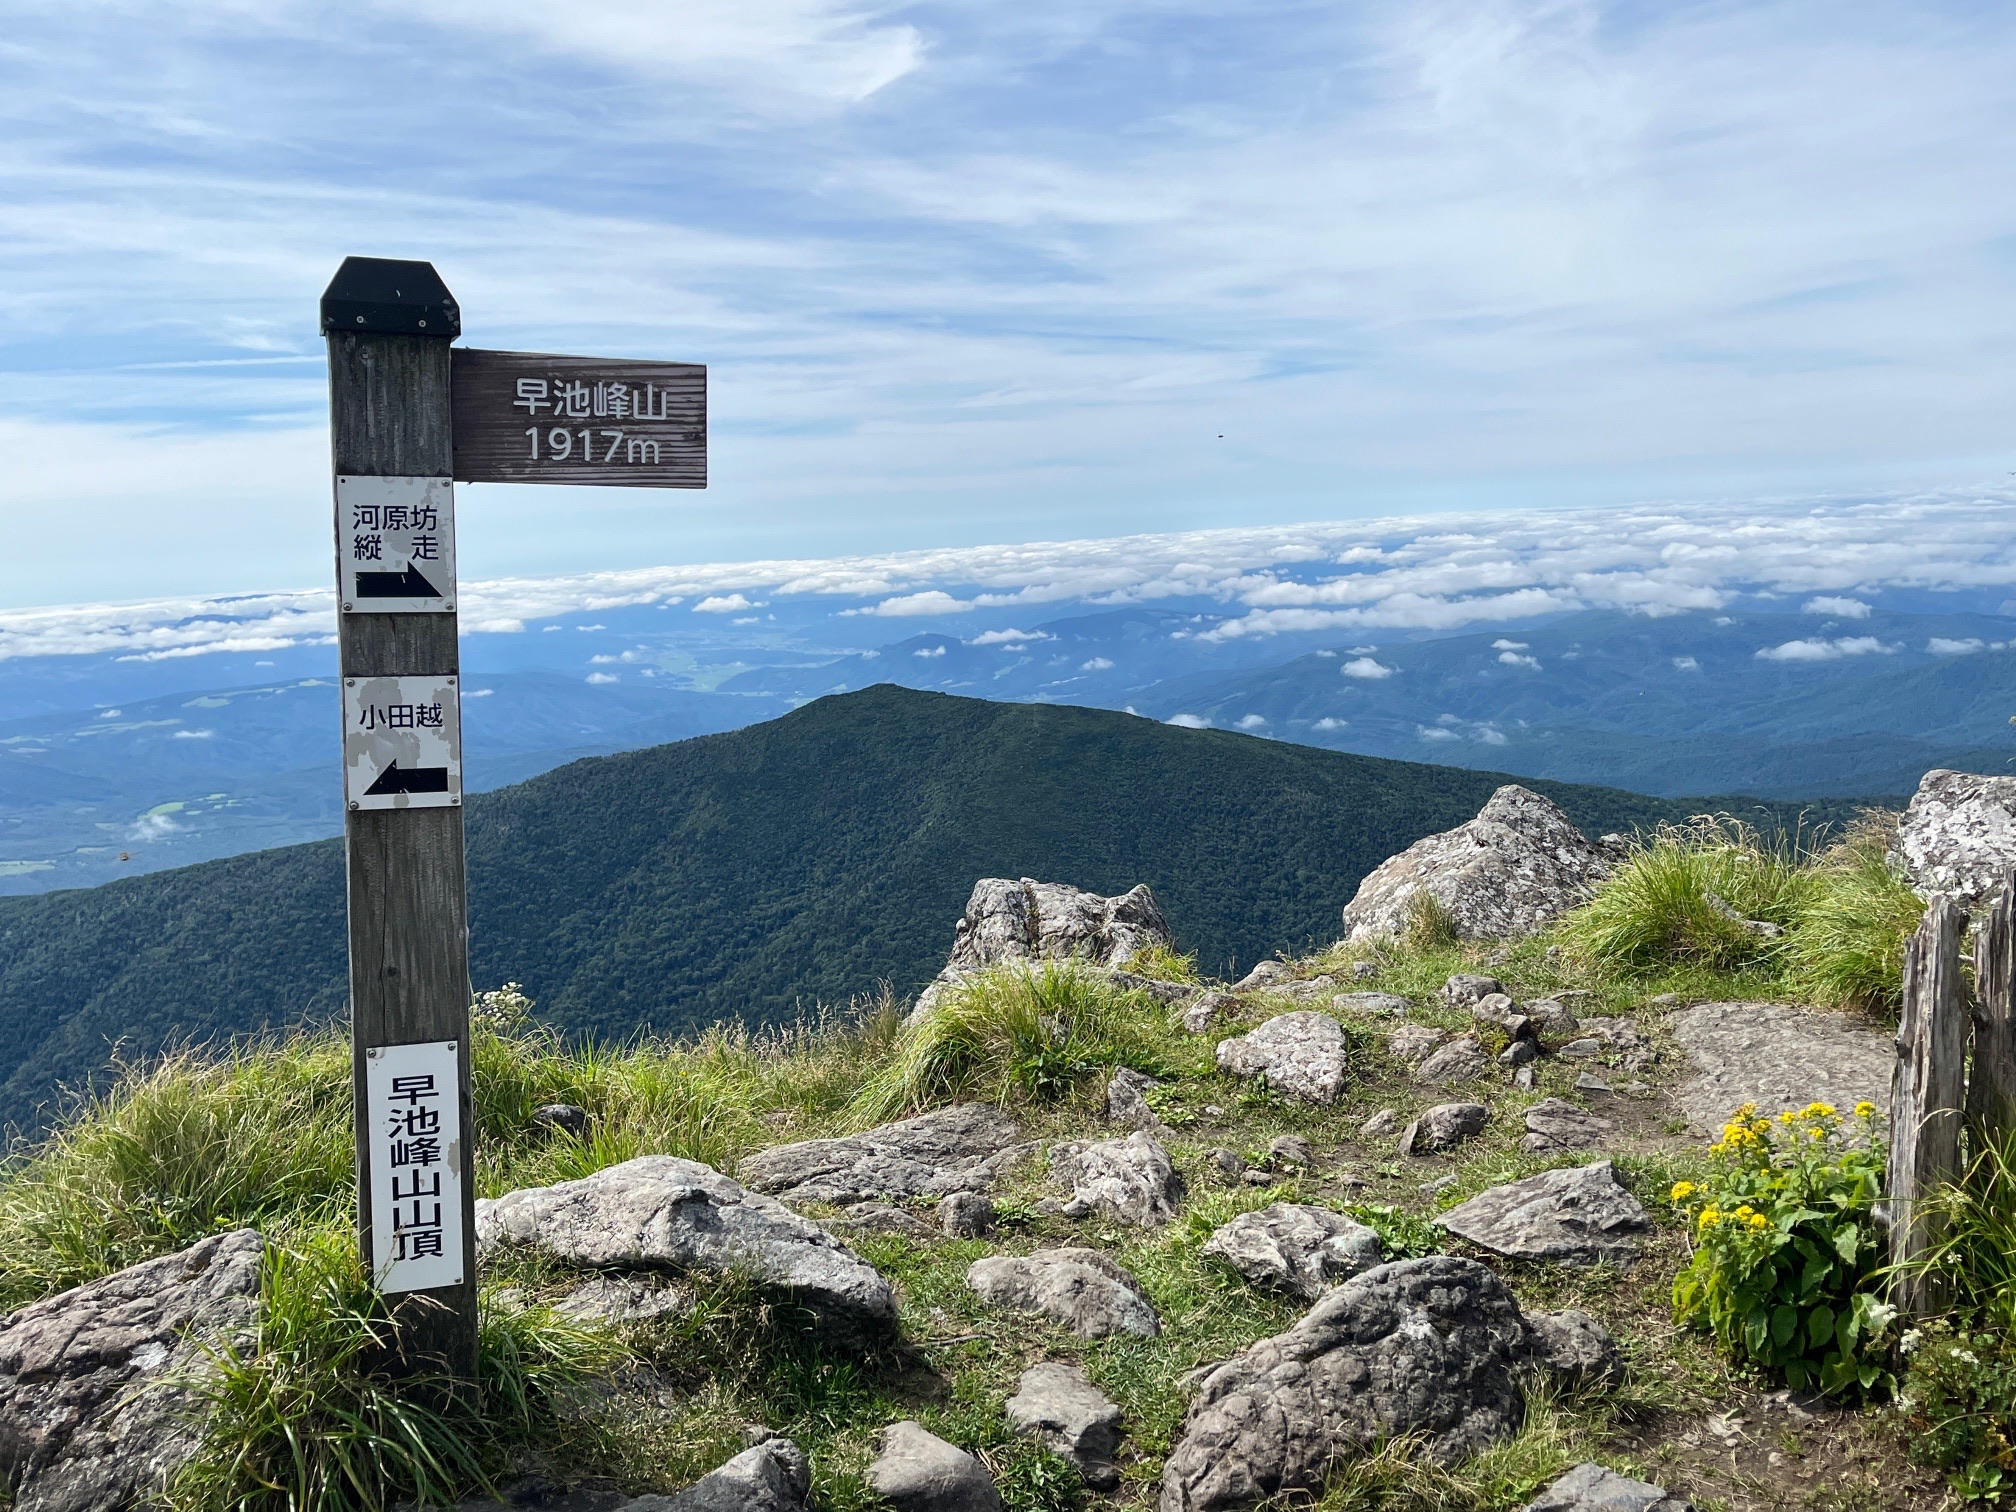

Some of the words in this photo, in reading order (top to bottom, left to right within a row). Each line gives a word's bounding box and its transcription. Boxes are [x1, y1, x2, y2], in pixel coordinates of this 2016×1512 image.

[513, 377, 668, 421] 早池峰山
[525, 426, 660, 465] 1917m
[352, 504, 438, 531] 河原坊
[359, 703, 444, 730] 小田越
[387, 1074, 444, 1262] 早池峰山山頂
